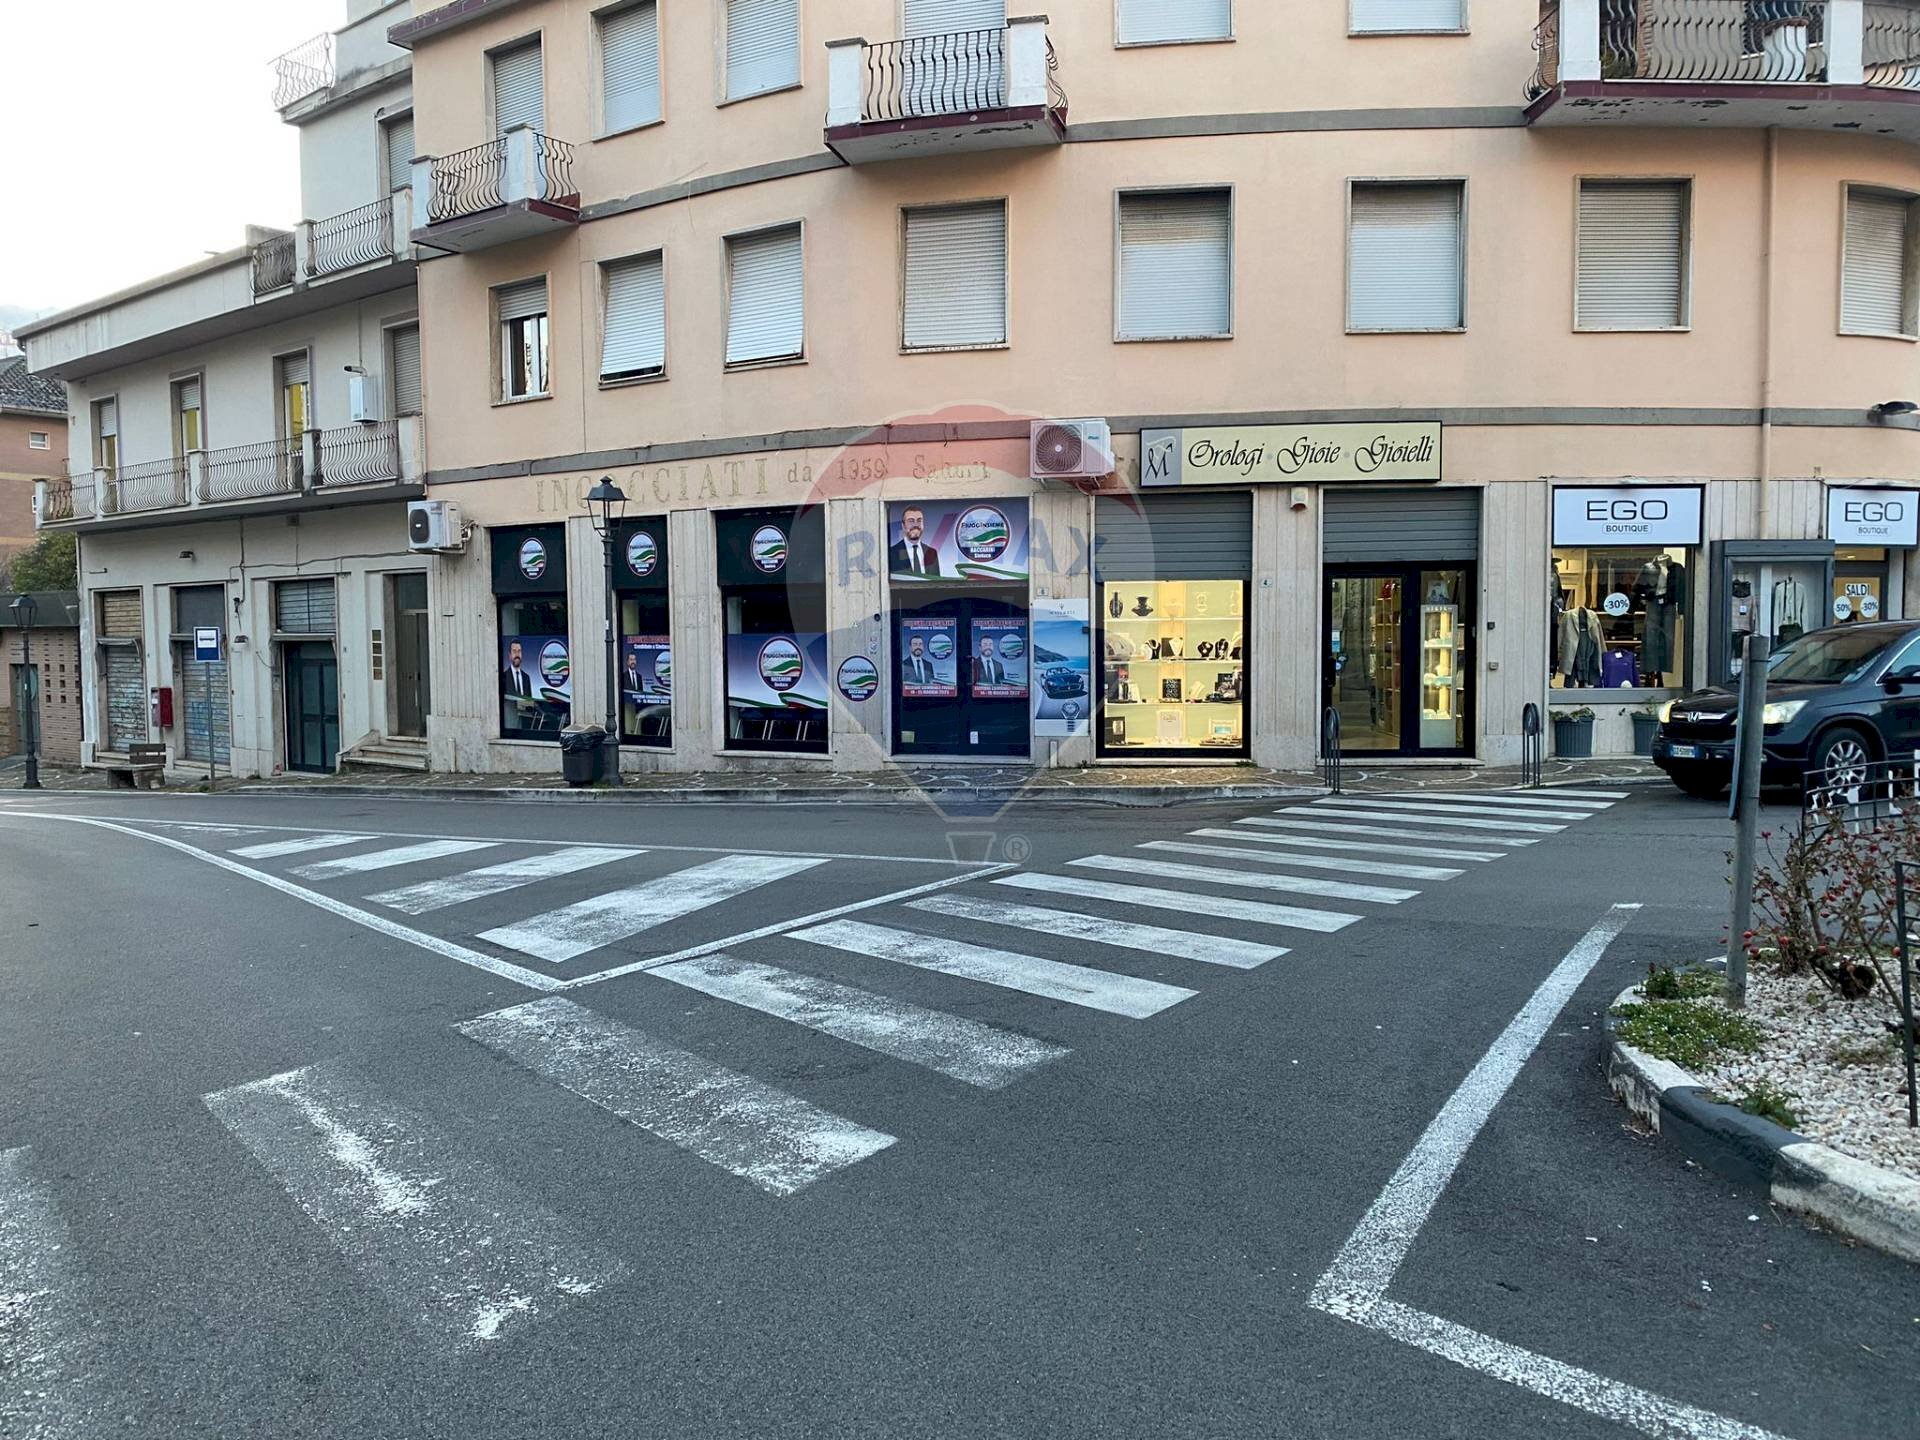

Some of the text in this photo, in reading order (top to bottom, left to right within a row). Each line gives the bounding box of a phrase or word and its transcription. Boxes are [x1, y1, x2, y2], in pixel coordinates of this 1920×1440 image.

[1188, 434, 1435, 476] Orologi Gioie Gioielli
[787, 462, 812, 483] da
[1586, 499, 1668, 521] EGO
[1844, 502, 1904, 522] EGO
[1605, 524, 1649, 533] BOUTIQUE
[1857, 526, 1889, 535] BOUTIQUE
[1846, 584, 1870, 596] SALDI
[1605, 599, 1629, 609] -30%
